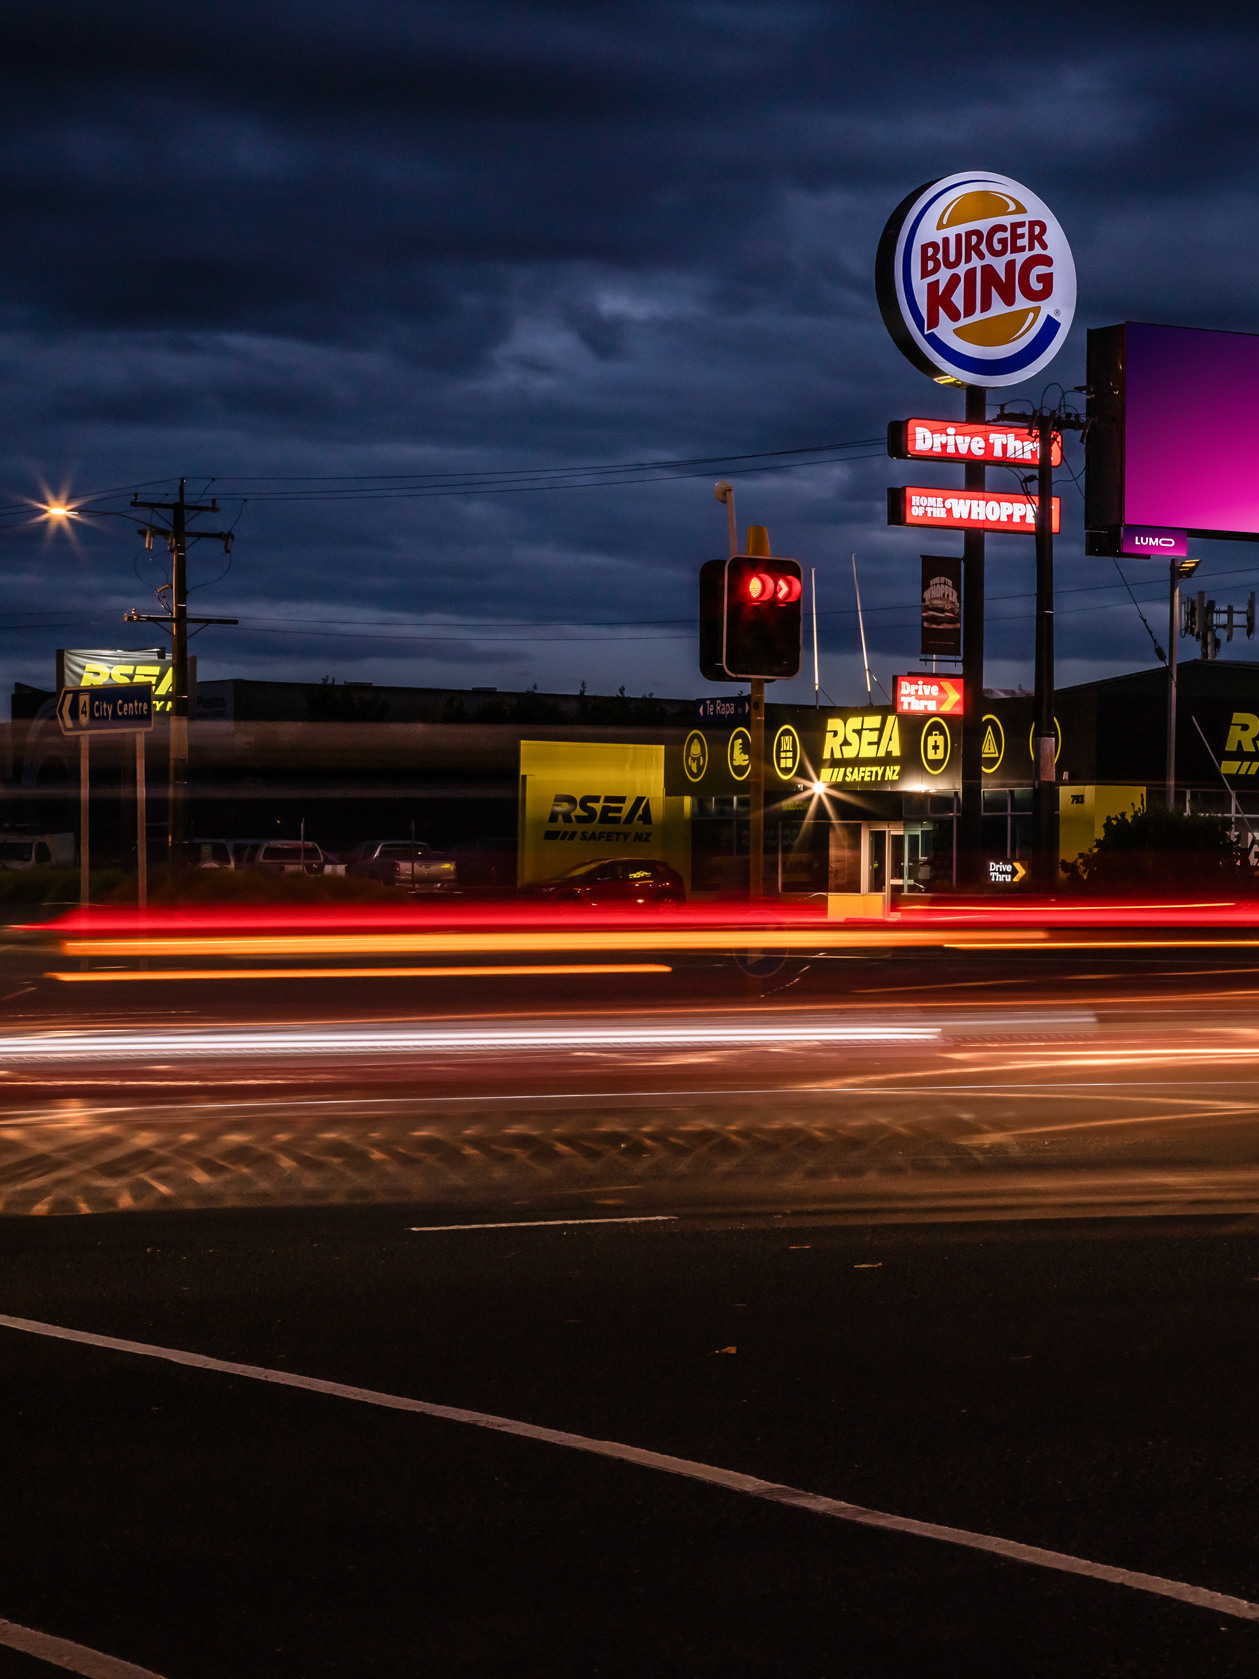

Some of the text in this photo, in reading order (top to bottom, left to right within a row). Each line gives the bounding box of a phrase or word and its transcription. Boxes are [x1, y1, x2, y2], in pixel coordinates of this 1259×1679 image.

[921, 220, 1048, 280] BURGER
[927, 254, 1053, 332] KING
[915, 426, 985, 456] Drive
[911, 496, 943, 507] HOME
[911, 506, 946, 518] OF THE
[945, 498, 1053, 524] WHOPPE
[1135, 536, 1175, 547] LUMO
[901, 681, 939, 696] Drive
[81, 701, 88, 718] 4
[94, 701, 112, 720] City
[117, 699, 148, 716] Centre
[706, 699, 714, 715] Te
[716, 699, 735, 718] Rapa
[753, 701, 760, 710] 6
[901, 696, 937, 711] Thru
[823, 715, 900, 759] RSEA
[845, 765, 900, 782] SAFETY NZ
[548, 794, 652, 825] RSEA
[580, 831, 653, 842] SAFETY NZ
[989, 862, 1012, 872] Drive
[990, 872, 1012, 882] Thru
